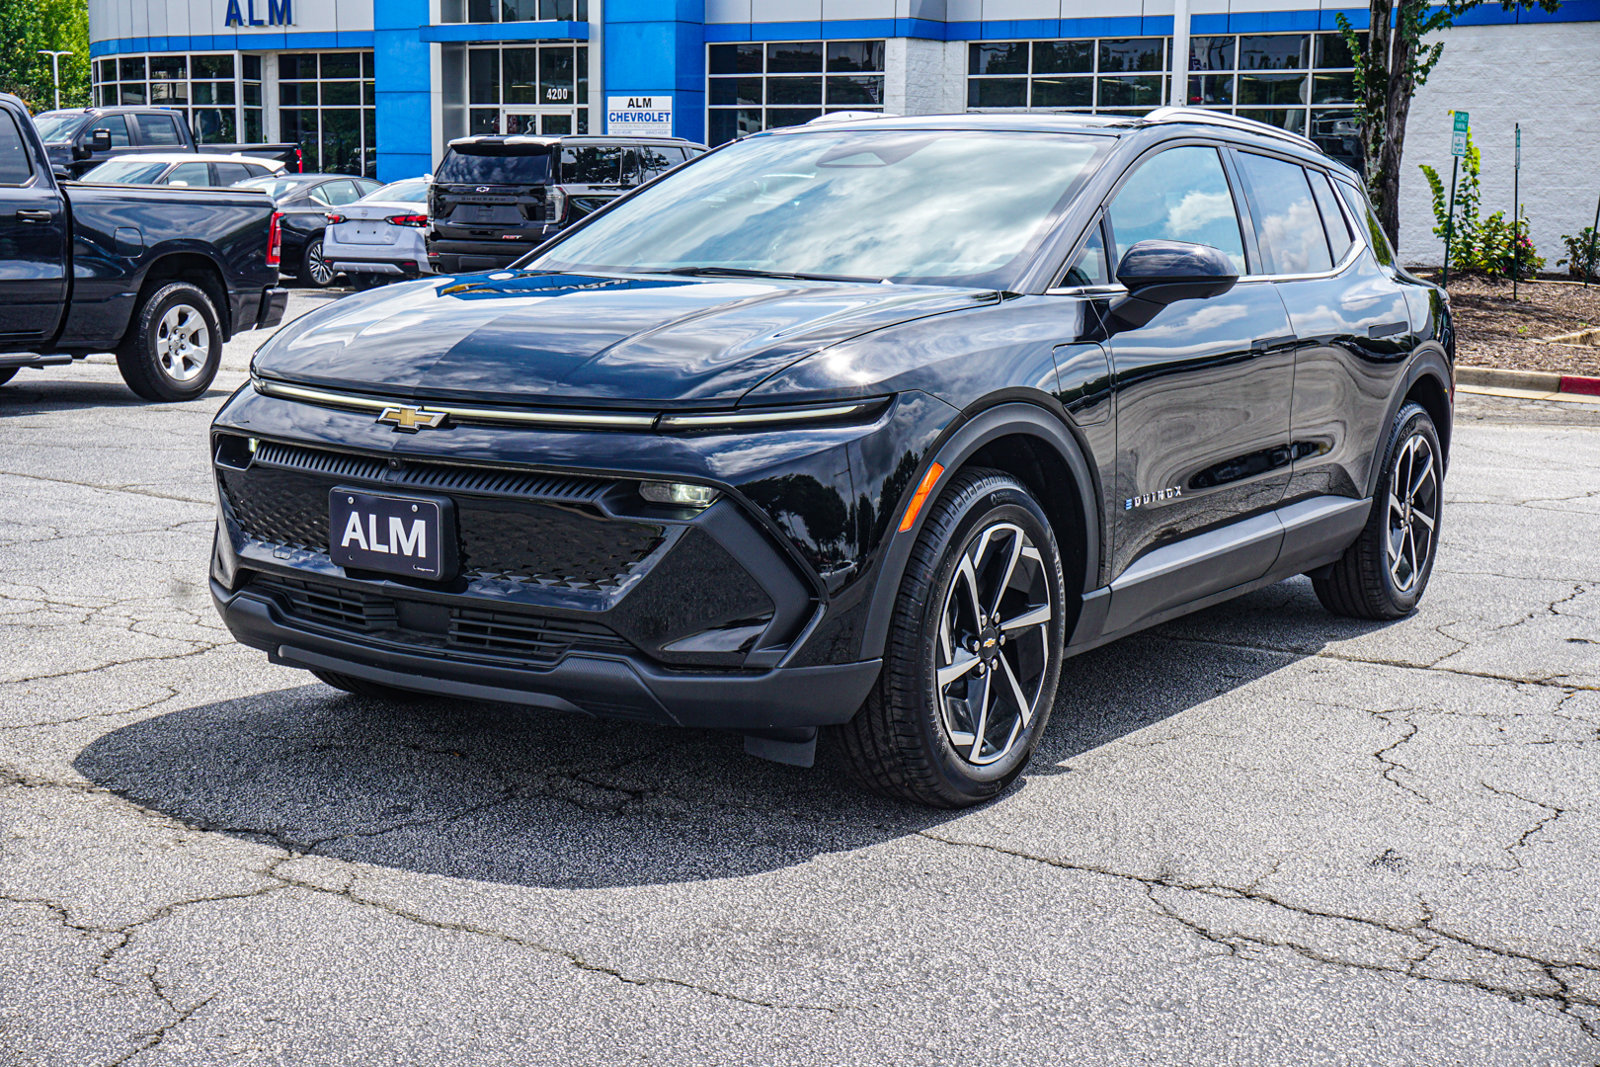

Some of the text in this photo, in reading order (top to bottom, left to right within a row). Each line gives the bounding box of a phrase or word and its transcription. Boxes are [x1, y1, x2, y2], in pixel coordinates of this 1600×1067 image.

[225, 0, 292, 26] ALM
[546, 88, 568, 100] 4200
[627, 97, 652, 109] ALM
[609, 112, 671, 122] CHEVROLET
[1125, 485, 1182, 511] EQUINOX
[340, 511, 426, 558] ALM
